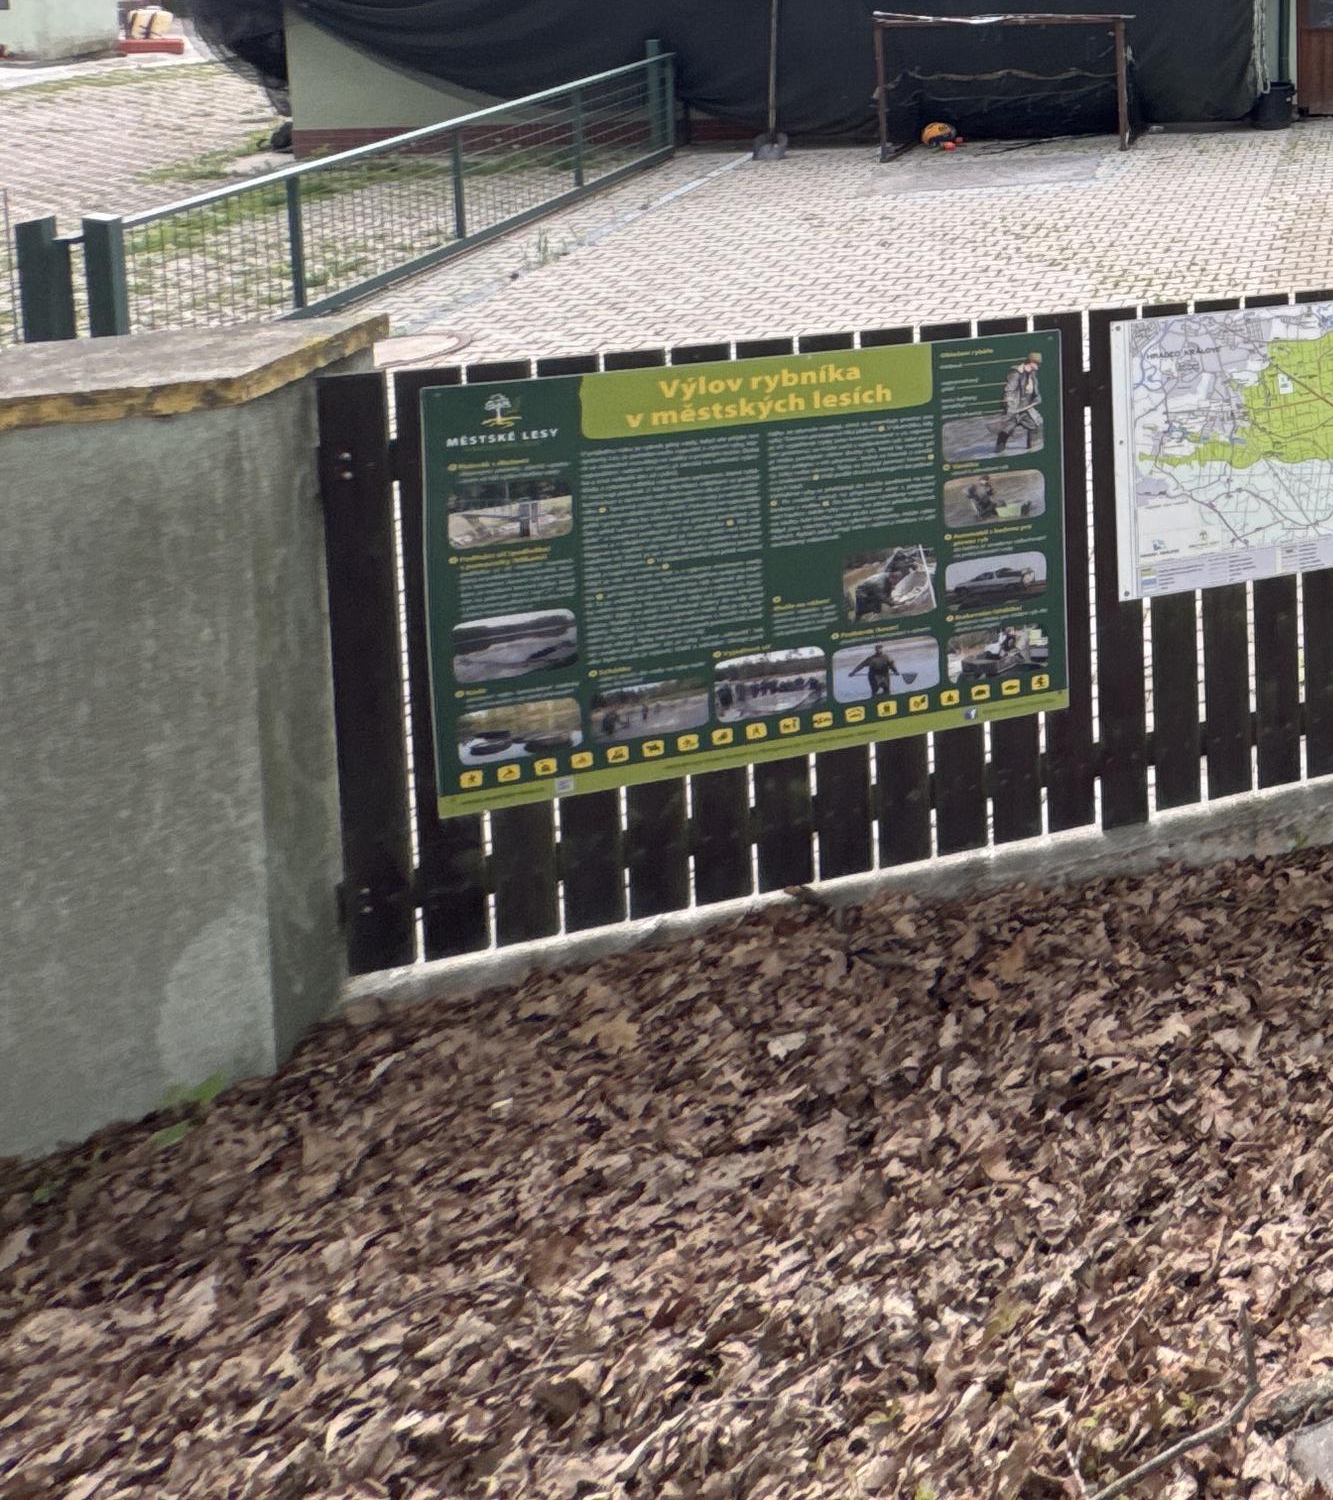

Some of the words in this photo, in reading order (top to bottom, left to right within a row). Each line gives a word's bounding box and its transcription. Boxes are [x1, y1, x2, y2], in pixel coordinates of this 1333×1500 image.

[660, 376, 743, 401] Výlov
[750, 363, 861, 393] rybníka
[625, 412, 645, 427] v
[651, 393, 805, 426] městských
[813, 383, 893, 409] lesích
[446, 431, 515, 447] MĚSTSKÉ
[522, 428, 559, 440] LESY
